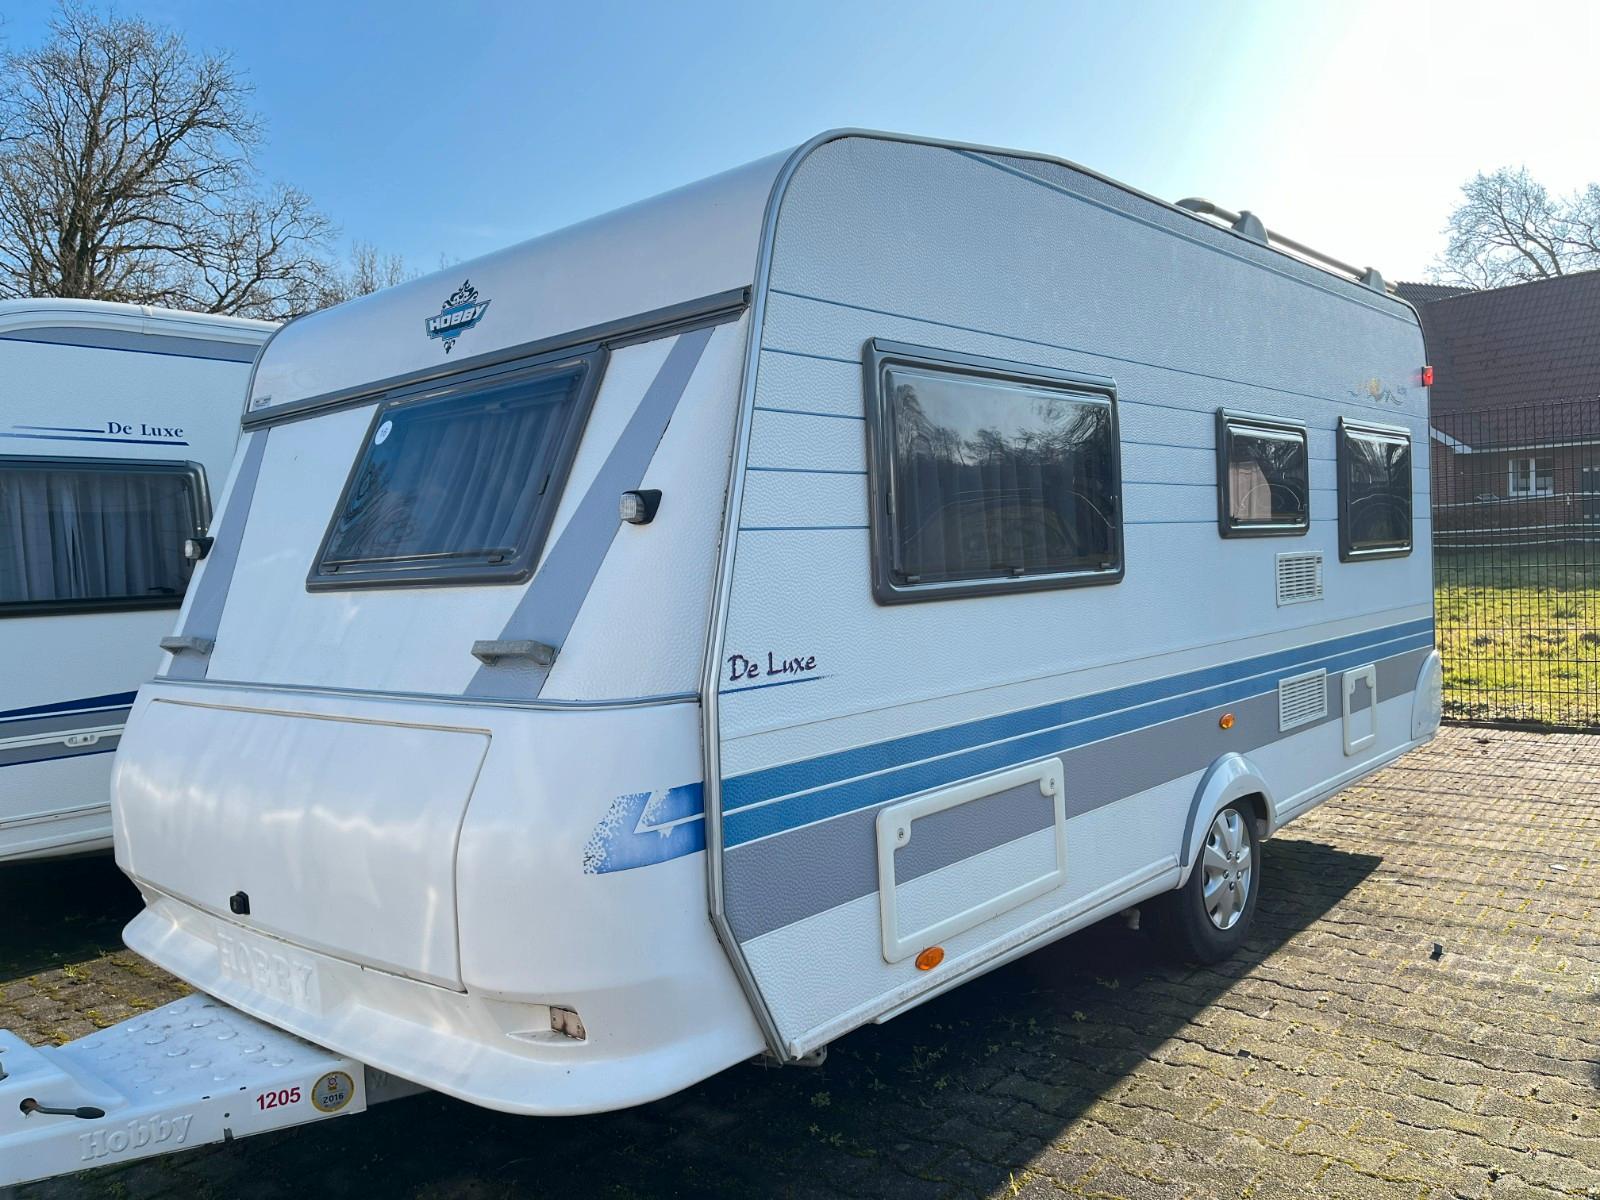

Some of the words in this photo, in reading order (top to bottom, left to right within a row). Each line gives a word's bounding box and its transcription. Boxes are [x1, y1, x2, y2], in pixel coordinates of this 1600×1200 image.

[429, 303, 486, 331] HOBBY
[106, 421, 133, 435] De
[140, 423, 184, 438] Luxe
[727, 654, 760, 681] De
[766, 651, 817, 676] Luxe
[216, 932, 313, 1003] HOBBY
[256, 1086, 301, 1111] 1205
[79, 1113, 193, 1161] Hobby
